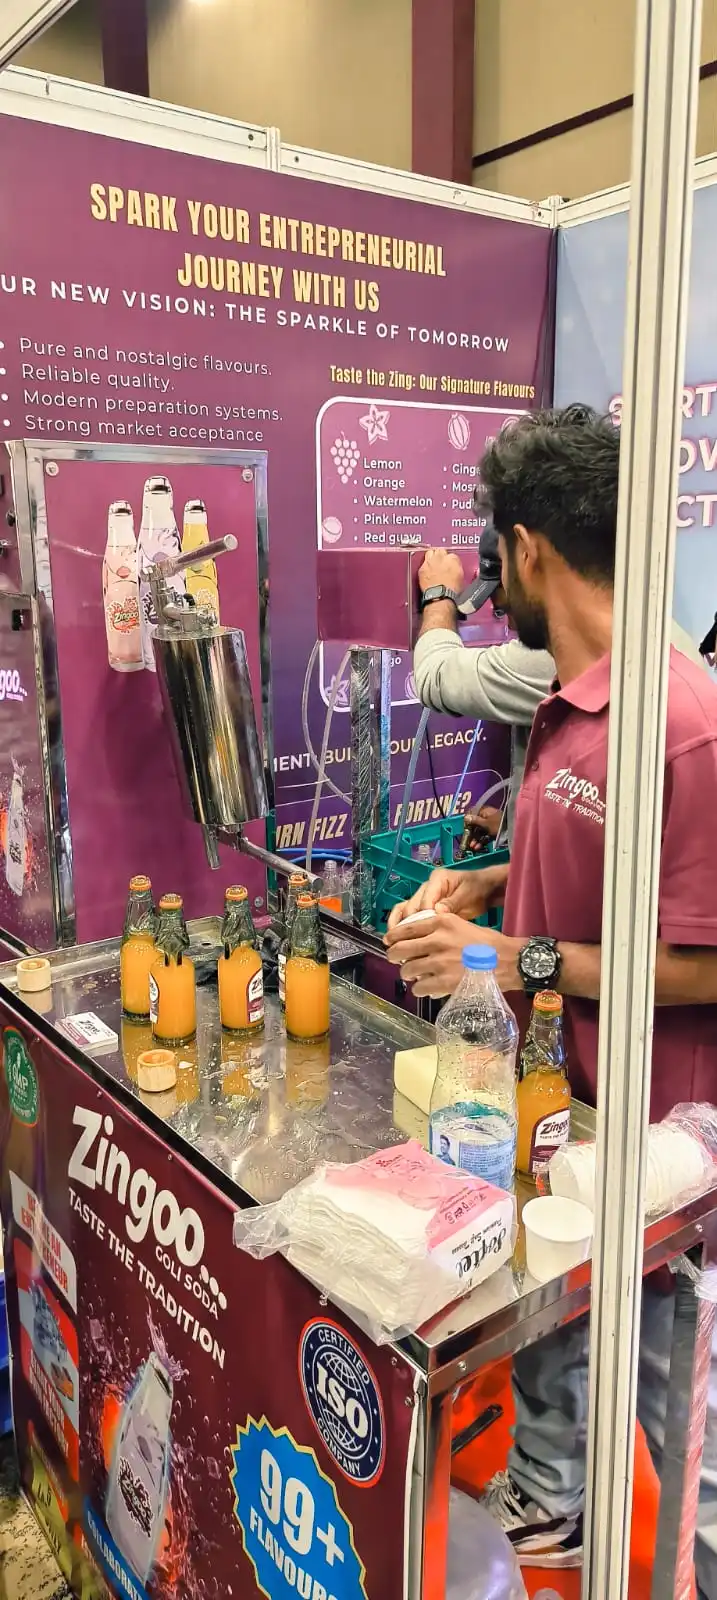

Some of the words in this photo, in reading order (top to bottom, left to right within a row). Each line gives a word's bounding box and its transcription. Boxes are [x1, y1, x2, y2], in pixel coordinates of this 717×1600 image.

[89, 183, 179, 234] SPARK
[187, 199, 250, 244] YOUR
[260, 212, 447, 277] ENTREPRENEURIAL
[177, 252, 285, 301] JOURNEY
[292, 270, 346, 309] WITH
[353, 280, 380, 313] US
[50, 280, 110, 305] NEW
[122, 289, 215, 318] VISION:
[224, 303, 267, 324] THE
[276, 310, 367, 336] SPARKLE
[376, 322, 399, 340] OF
[408, 326, 509, 353] TOMORROW
[19, 337, 66, 357] Pure
[73, 343, 109, 362] and
[115, 348, 199, 371] nostalgic
[203, 354, 272, 376] flavours.
[22, 364, 101, 386] Reliable
[107, 373, 175, 393] quality.
[330, 364, 363, 385] Taste
[366, 368, 385, 387] the
[388, 371, 416, 391] Zing:
[419, 373, 438, 392] Our
[440, 375, 491, 397] Signature
[493, 380, 535, 400] Flavours
[24, 389, 98, 410] Modern
[105, 395, 209, 417] preparation
[214, 403, 284, 422] systems.
[24, 415, 92, 437] Strong
[98, 418, 163, 438] market
[168, 425, 264, 444] acceptance
[363, 457, 402, 471] Lemon
[363, 476, 406, 491] Orange
[364, 495, 433, 507] Watermelon
[364, 514, 390, 526] Pink
[392, 514, 427, 526] lemon
[364, 532, 386, 543] Red
[451, 517, 487, 527] masala
[311, 813, 348, 842] FIZZ
[393, 791, 472, 826] FORTUNE?
[68, 1187, 105, 1241] TASTE
[107, 1229, 134, 1272] THE
[137, 1259, 226, 1370] TRADITION
[155, 1245, 181, 1283] GOLI
[183, 1272, 219, 1320] SODA
[318, 1328, 371, 1385] CERTIFIED
[316, 1360, 369, 1438] ISO
[317, 1417, 361, 1476] COMPANY
[260, 1448, 345, 1567] 99+
